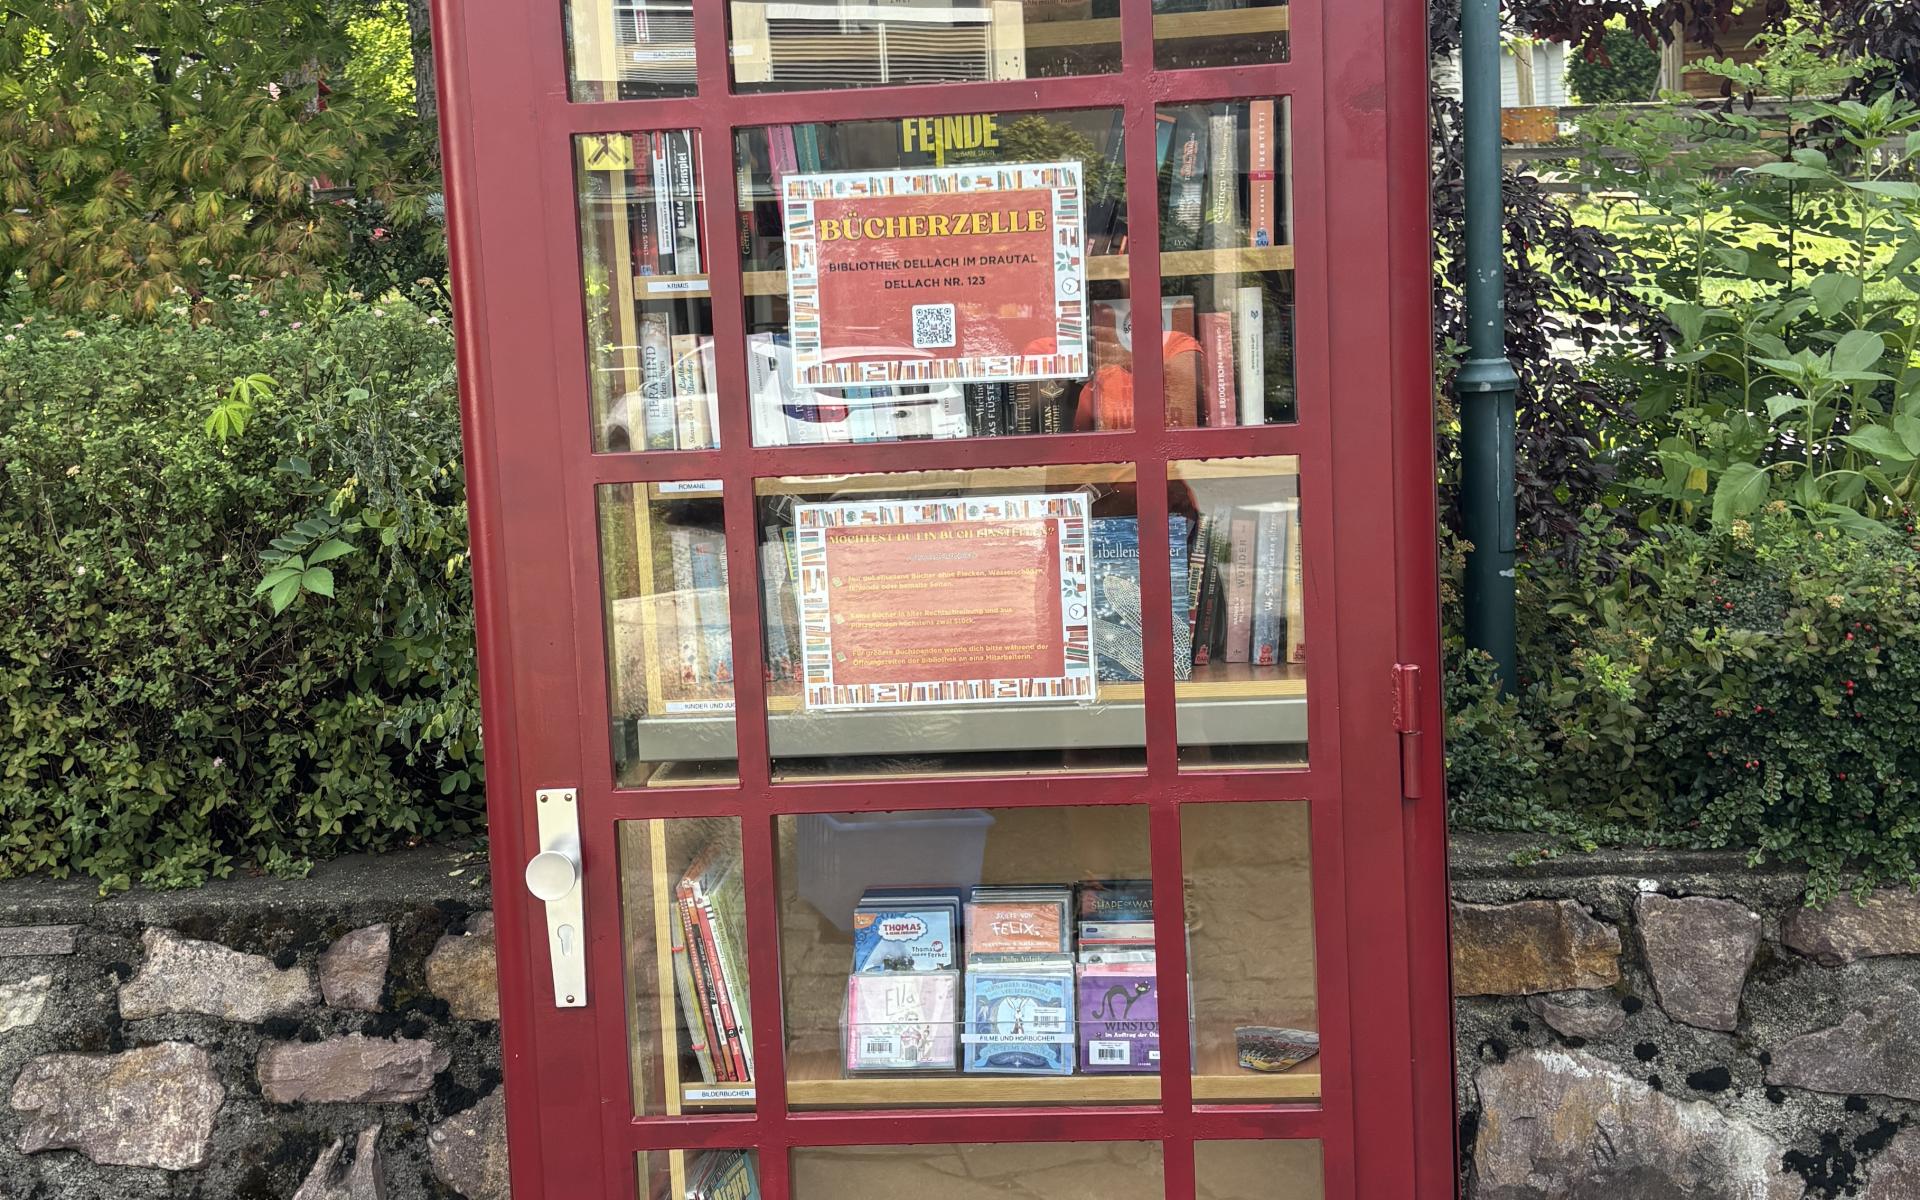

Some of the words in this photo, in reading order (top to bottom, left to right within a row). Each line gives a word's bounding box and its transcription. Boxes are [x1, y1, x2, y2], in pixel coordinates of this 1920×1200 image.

[902, 113, 999, 166] FEINDE
[678, 152, 690, 196] Laienspiel
[677, 200, 686, 229] PIPER
[1214, 180, 1226, 223] Gerritsen
[819, 208, 1047, 241] BÜCHERZELLE
[829, 258, 900, 272] BIBLIOTHEK
[903, 256, 959, 270] DELLACH
[962, 256, 976, 267] IM
[979, 254, 1038, 266] DRAUTAL
[884, 278, 941, 290] DELLACH
[943, 277, 964, 287] NR.
[967, 276, 986, 287] 123
[646, 345, 658, 378] LIND
[648, 382, 660, 418] HERA
[1238, 540, 1249, 588] WUNDER
[883, 923, 922, 931] THOMAS
[990, 919, 1035, 936] FELIX
[885, 984, 917, 1016] Ella
[1104, 1021, 1159, 1031] WINSTO
